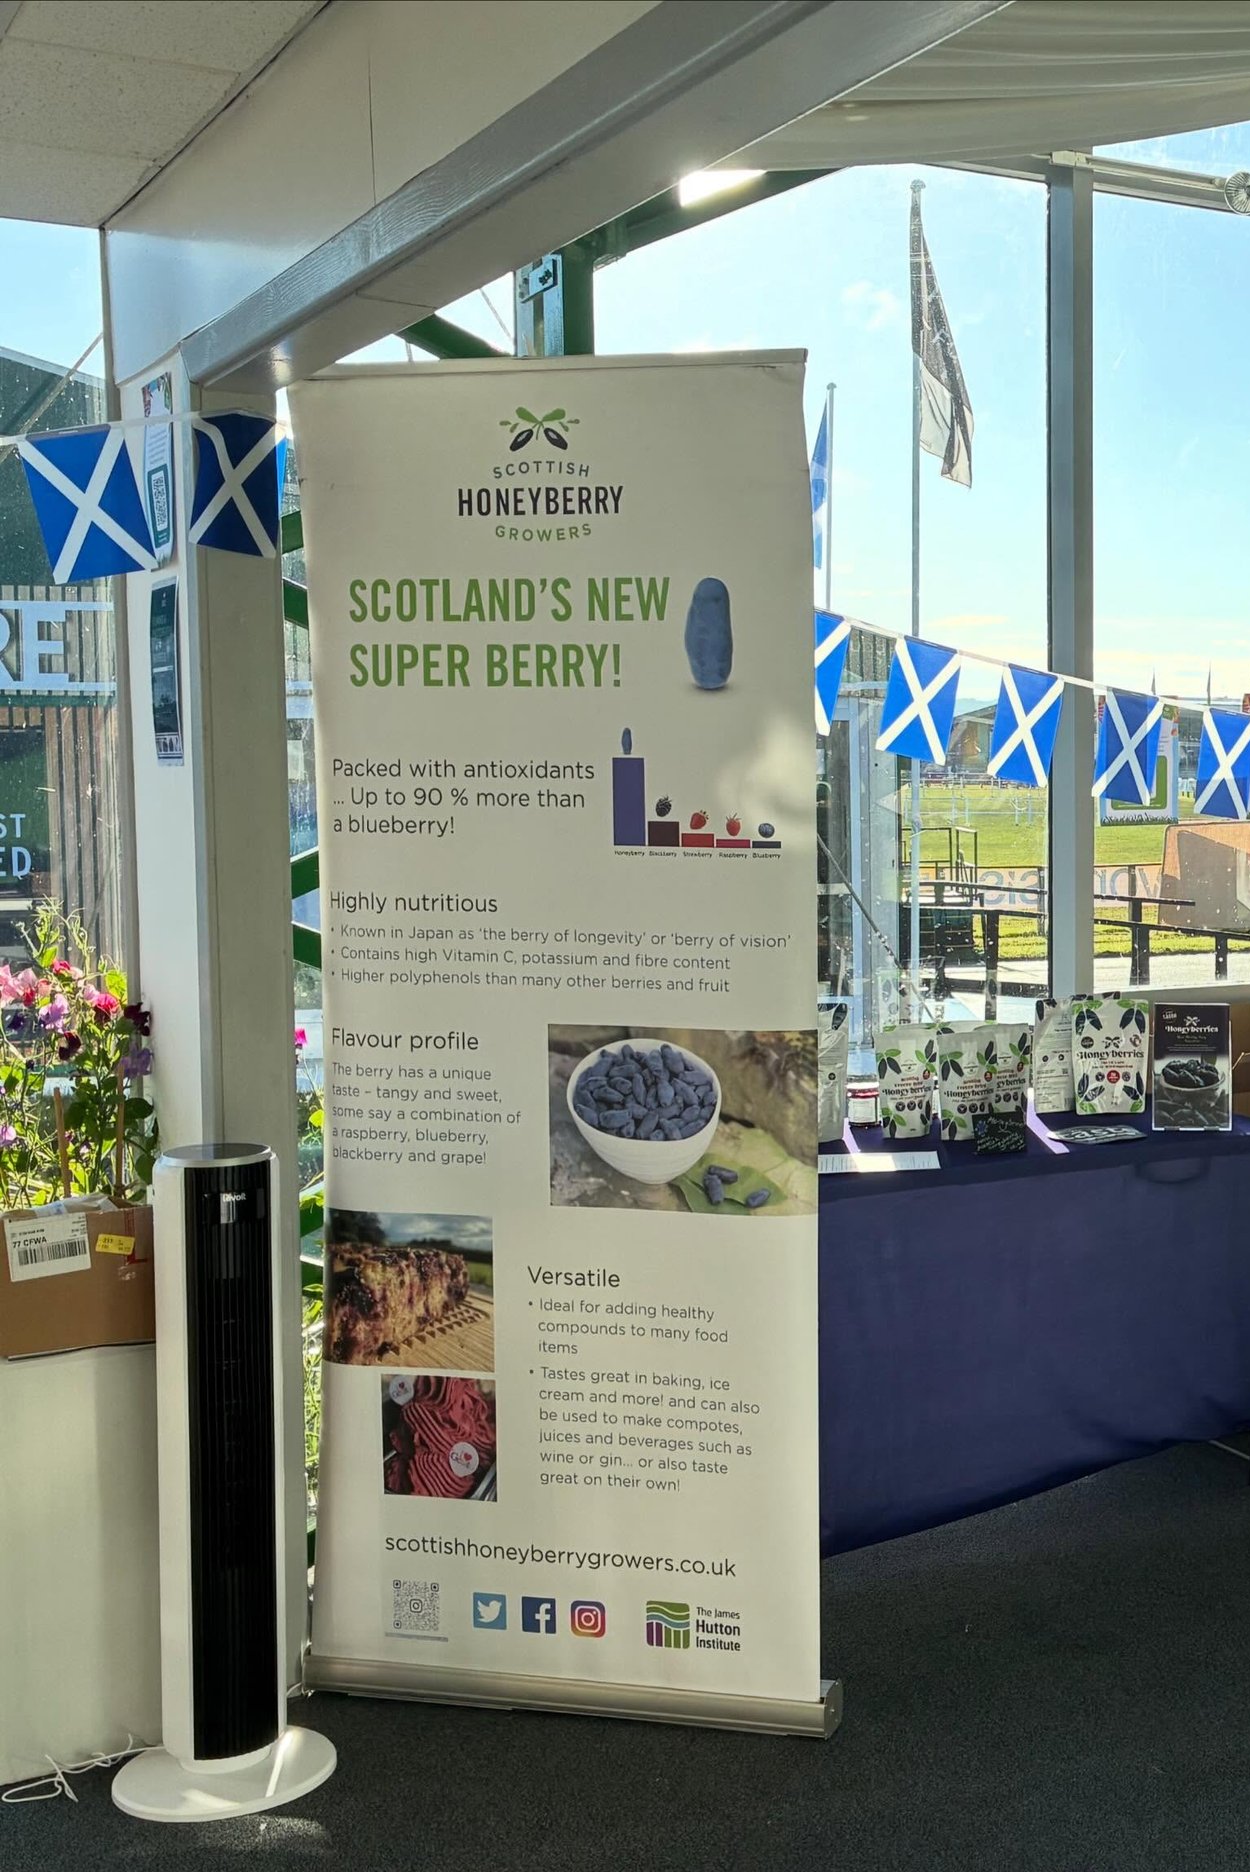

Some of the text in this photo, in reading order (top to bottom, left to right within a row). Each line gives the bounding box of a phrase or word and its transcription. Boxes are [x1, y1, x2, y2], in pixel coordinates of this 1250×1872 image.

[493, 460, 591, 479] SCOTTISH
[458, 485, 623, 517] HONEYBERRY
[495, 524, 592, 542] GROWERS
[349, 576, 670, 623] SCOTLAND'S NEW
[349, 643, 622, 688] SUPER BERRY!
[333, 758, 594, 779] Packed with antioxidants
[351, 787, 377, 808] Up
[385, 788, 405, 806] to
[413, 788, 442, 806] 90
[450, 788, 469, 806] %
[476, 792, 529, 807] more
[537, 789, 585, 808] than
[333, 815, 455, 837] a blueberry!
[330, 892, 498, 914] Highly nutritious
[341, 924, 386, 938] Known
[390, 926, 403, 939] in
[408, 927, 453, 942] Japan
[458, 929, 474, 940] as
[511, 928, 549, 944] berry
[554, 929, 569, 942] of
[651, 933, 666, 945] or
[719, 934, 735, 947] of
[341, 947, 730, 970] Contains high Vitamin C, potassium and fibre content
[341, 969, 730, 992] Higher polyphenols than many other berries and fruit
[332, 1028, 479, 1052] Flavour profile
[332, 1062, 492, 1082] The berry has a unique
[332, 1084, 360, 1097] taste
[377, 1086, 418, 1101] tangy
[424, 1088, 451, 1099] and
[457, 1089, 502, 1103] sweet,
[332, 1106, 521, 1124] some say a combination of
[332, 1128, 489, 1145] a raspberry, blueberry,
[333, 1148, 486, 1166] blackberry and grape!
[528, 1265, 620, 1288] Versatile
[540, 1299, 714, 1322] Ideal for adding healthy
[538, 1321, 728, 1343] compounds to many food
[538, 1340, 578, 1354] items
[541, 1366, 730, 1391] Tastes great in baking, ice
[539, 1389, 760, 1414] cream and more! and can also
[539, 1408, 743, 1435] be used to make compotes,
[539, 1429, 752, 1456] juices and beverages such as
[540, 1451, 728, 1474] wine or gin... or also taste
[540, 1472, 680, 1492] great on their own!
[385, 1536, 736, 1578] scottishhoneyberrygrowers.co.uk
[696, 1607, 740, 1619] The James
[696, 1619, 740, 1636] Hutton
[696, 1636, 740, 1651] Institute
